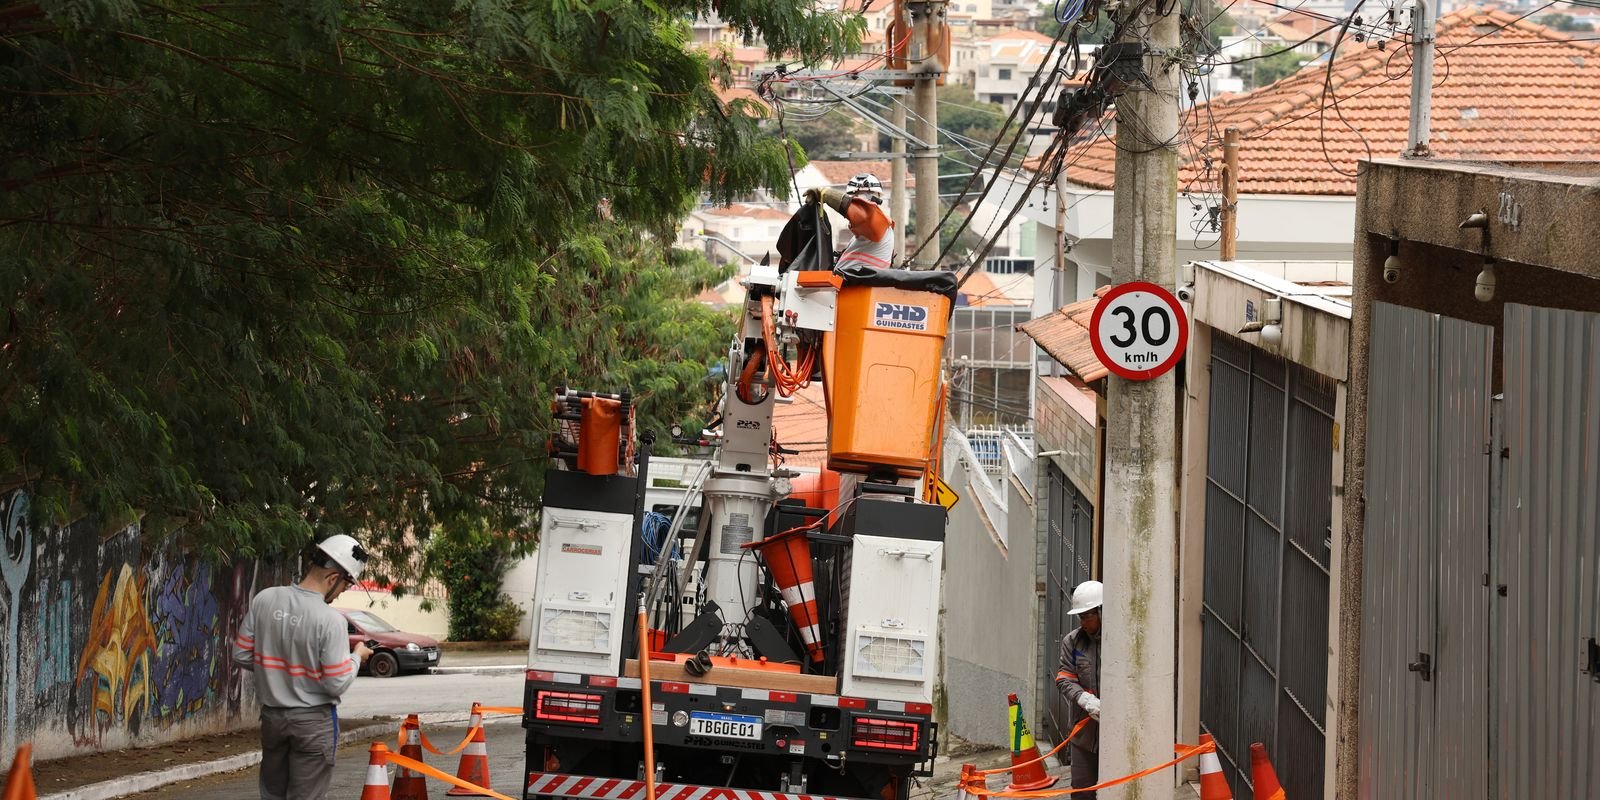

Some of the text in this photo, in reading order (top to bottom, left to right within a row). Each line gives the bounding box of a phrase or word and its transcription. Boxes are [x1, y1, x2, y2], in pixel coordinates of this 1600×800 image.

[876, 303, 926, 321] PHD
[876, 320, 925, 330] GUINDASTES
[1109, 305, 1171, 348] 30
[1124, 351, 1158, 363] km/h
[737, 419, 760, 427] PHD
[697, 719, 755, 737] TBG0E01
[684, 736, 712, 746] PHD
